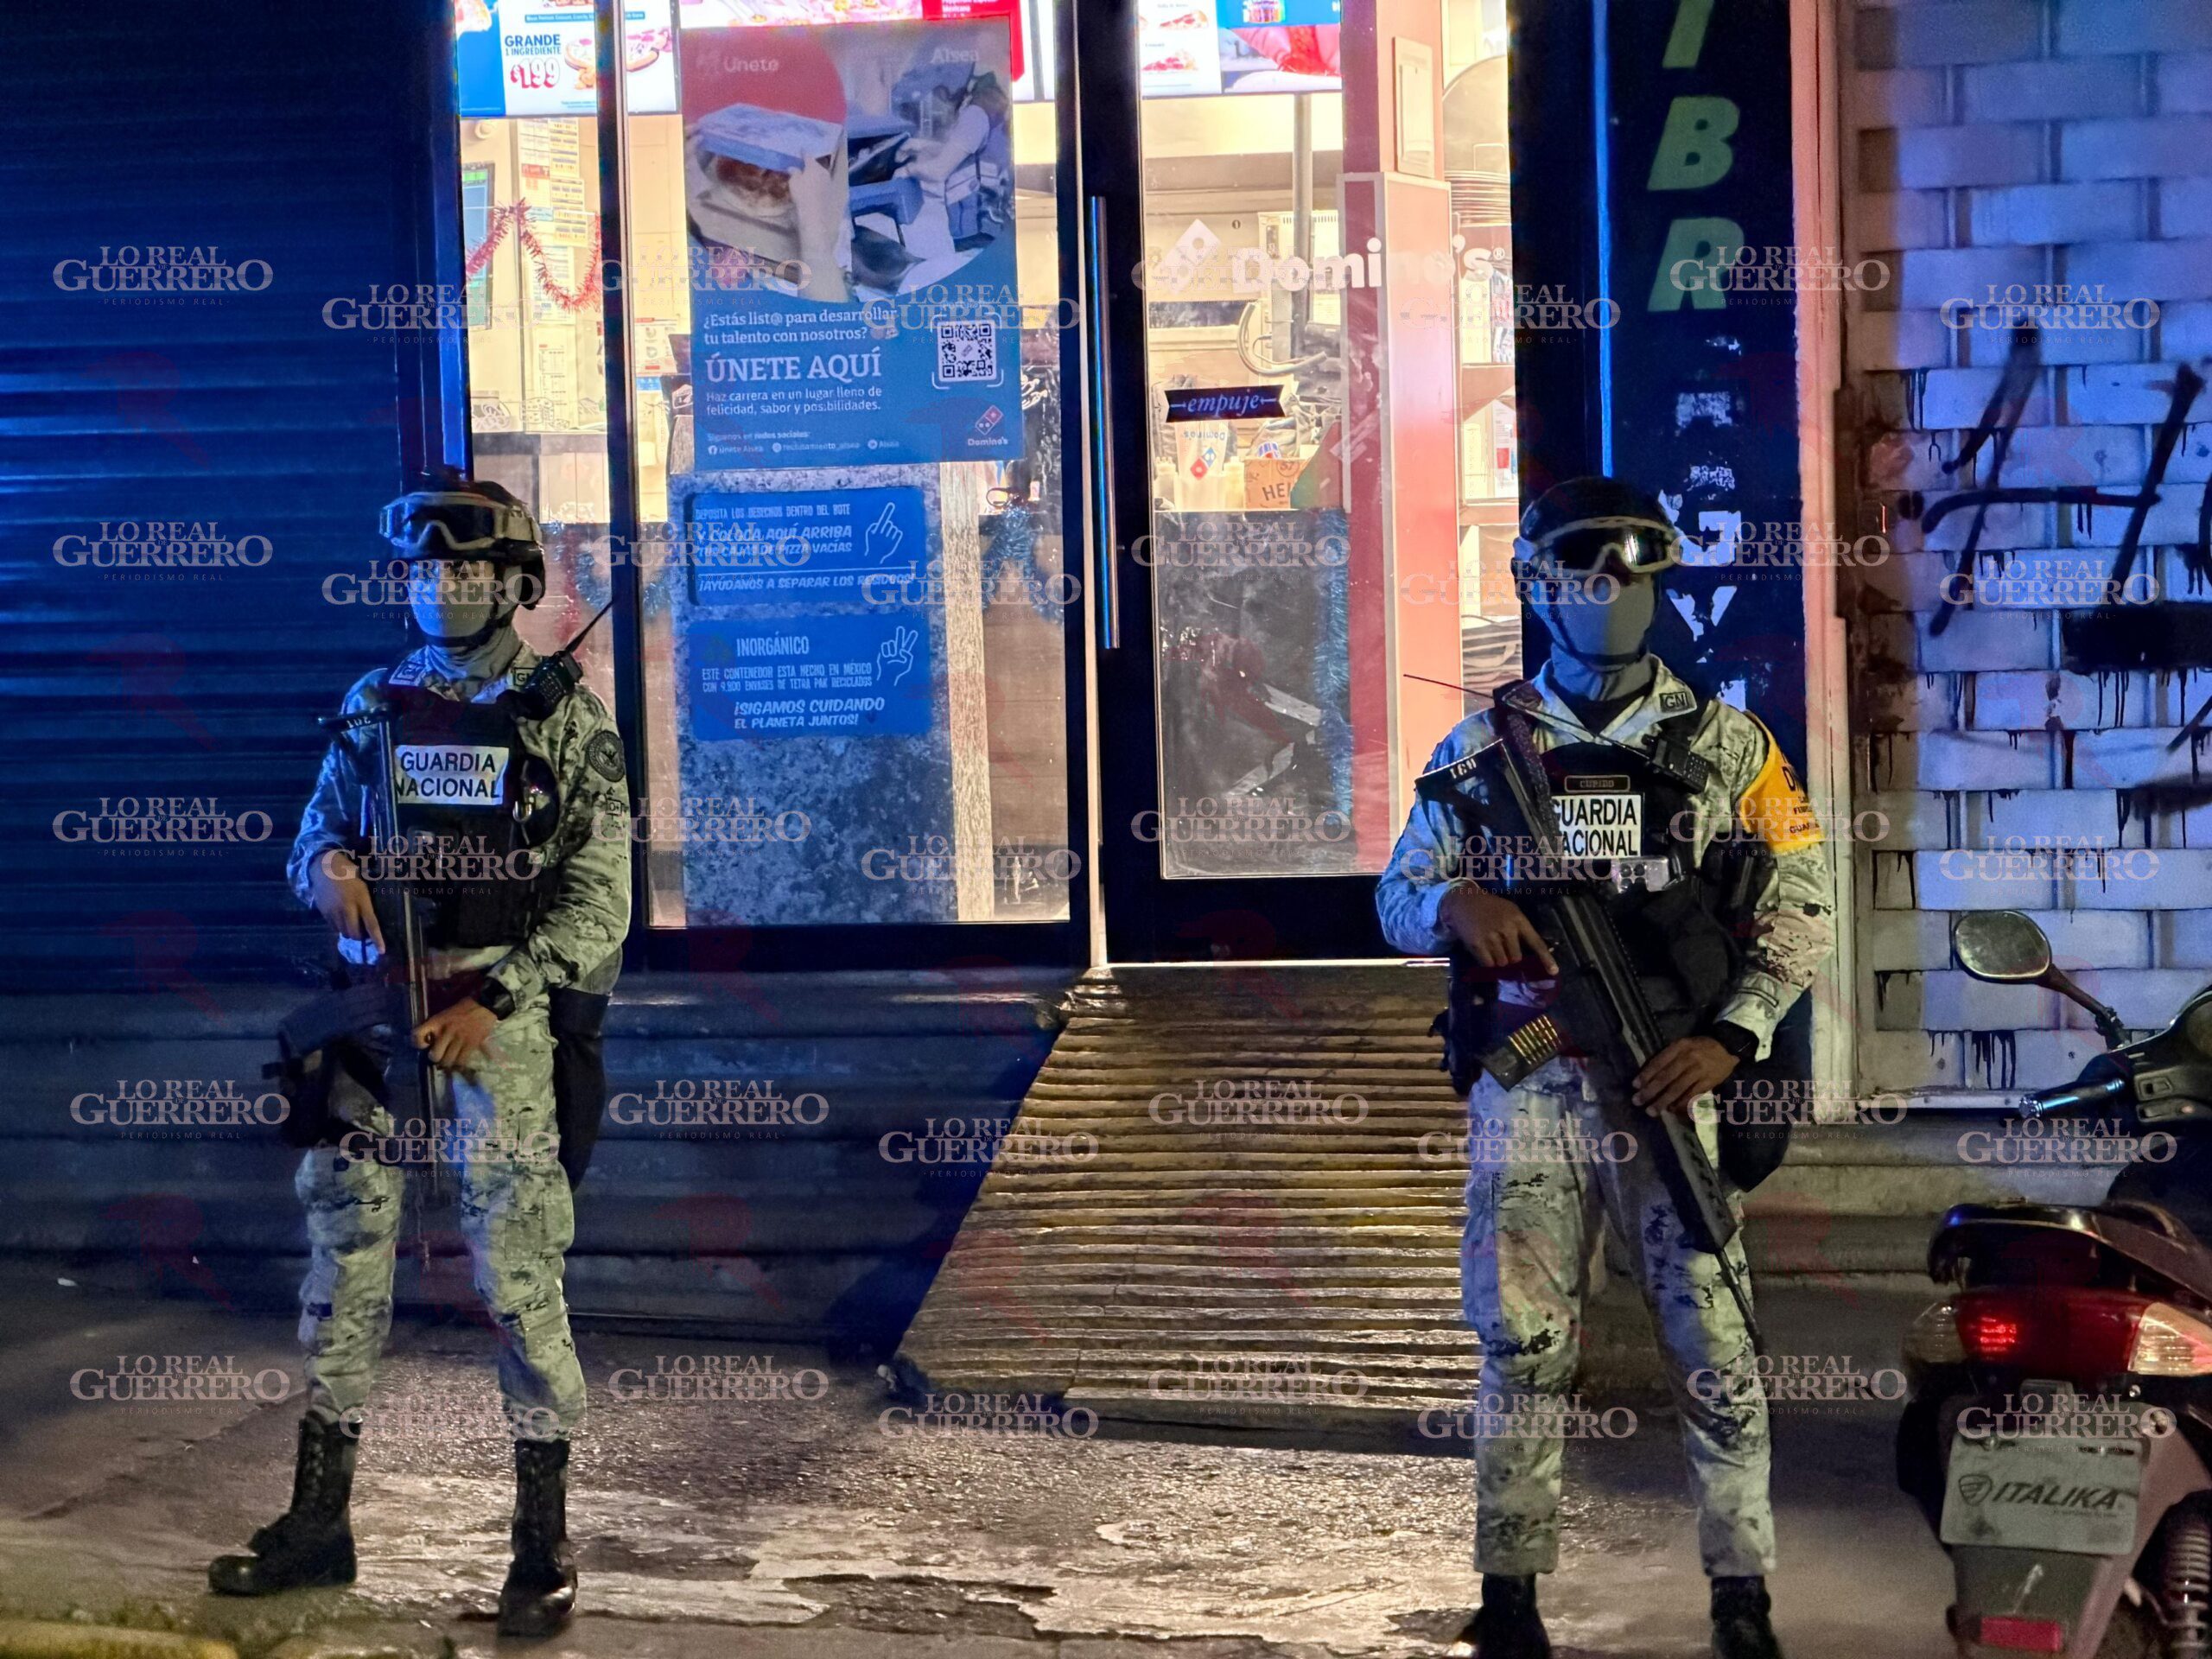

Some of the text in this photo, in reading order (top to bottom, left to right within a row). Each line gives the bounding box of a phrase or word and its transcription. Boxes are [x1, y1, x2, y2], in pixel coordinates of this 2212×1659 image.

[505, 35, 561, 48] GRANDE
[512, 46, 561, 55] INGREDIENTE
[510, 58, 560, 89] $199
[703, 307, 898, 329] ¿Estás list@ para desarrollar
[704, 327, 868, 345] tu talento con nosotros?
[705, 346, 882, 384] ÚNETE AQUÍ
[707, 386, 882, 402] Haz carrera en un lugar lleno de
[707, 401, 881, 416] felicidad, sabor y posibilidades.
[1186, 392, 1260, 416] empuje
[967, 436, 1008, 447] Domino's
[1262, 483, 1291, 501] HEI
[786, 505, 813, 517] DENTRO
[817, 505, 830, 516] DEL
[766, 523, 800, 539] AQUÍ
[801, 525, 852, 538] ARRIBA
[811, 539, 852, 554] VACÍAS
[766, 578, 775, 588] A
[778, 576, 830, 588] SEPARAR
[833, 575, 854, 587] LOS
[736, 631, 810, 657] INORGÁNICO
[702, 668, 720, 680] ESTE
[724, 666, 773, 679] CONTENEDOR
[800, 664, 824, 677] HECHO
[830, 664, 839, 675] EN
[843, 660, 872, 675] MÉXICO
[702, 682, 717, 692] CON
[745, 679, 773, 690] ENVASES
[778, 679, 785, 690] DE
[790, 678, 810, 690] TETRA
[814, 677, 828, 688] PAK
[831, 677, 872, 688] RECICLADOS
[734, 696, 885, 716] ¡SIGAMOS CUIDANDO
[1663, 694, 1687, 709] GN
[734, 714, 859, 729] EL PLANETA JUNTOS!
[400, 752, 496, 773] GUARDIA
[395, 777, 499, 798] NACIONAL
[1562, 830, 1638, 856] ACIONAL
[1993, 1482, 2118, 1510] ITALIKA
